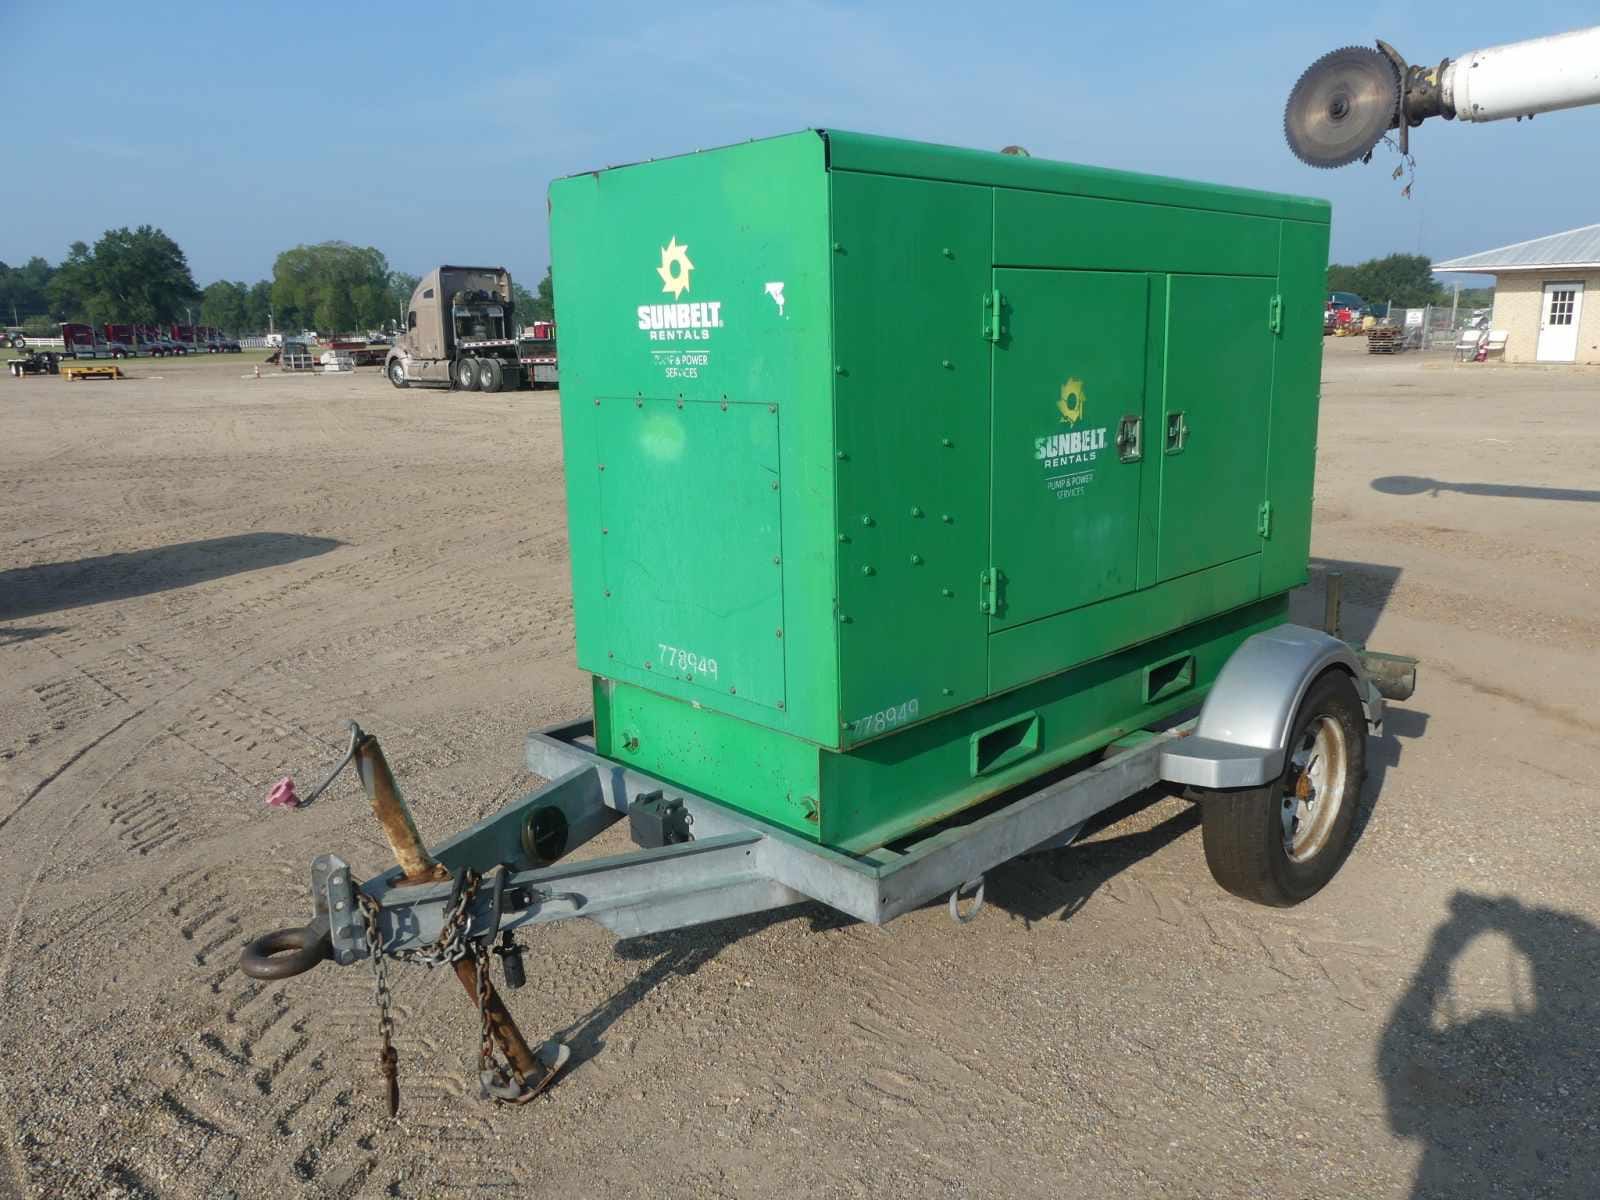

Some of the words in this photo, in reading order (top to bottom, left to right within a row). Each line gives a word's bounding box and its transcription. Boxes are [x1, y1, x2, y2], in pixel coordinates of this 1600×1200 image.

[638, 302, 720, 330] SUNBELT
[650, 330, 710, 340] RENTALS
[682, 355, 708, 365] POWER
[1034, 428, 1106, 459] SUNBELT
[1044, 452, 1096, 468] RENTALS
[658, 643, 718, 680] 778949
[851, 698, 918, 734] 778949
